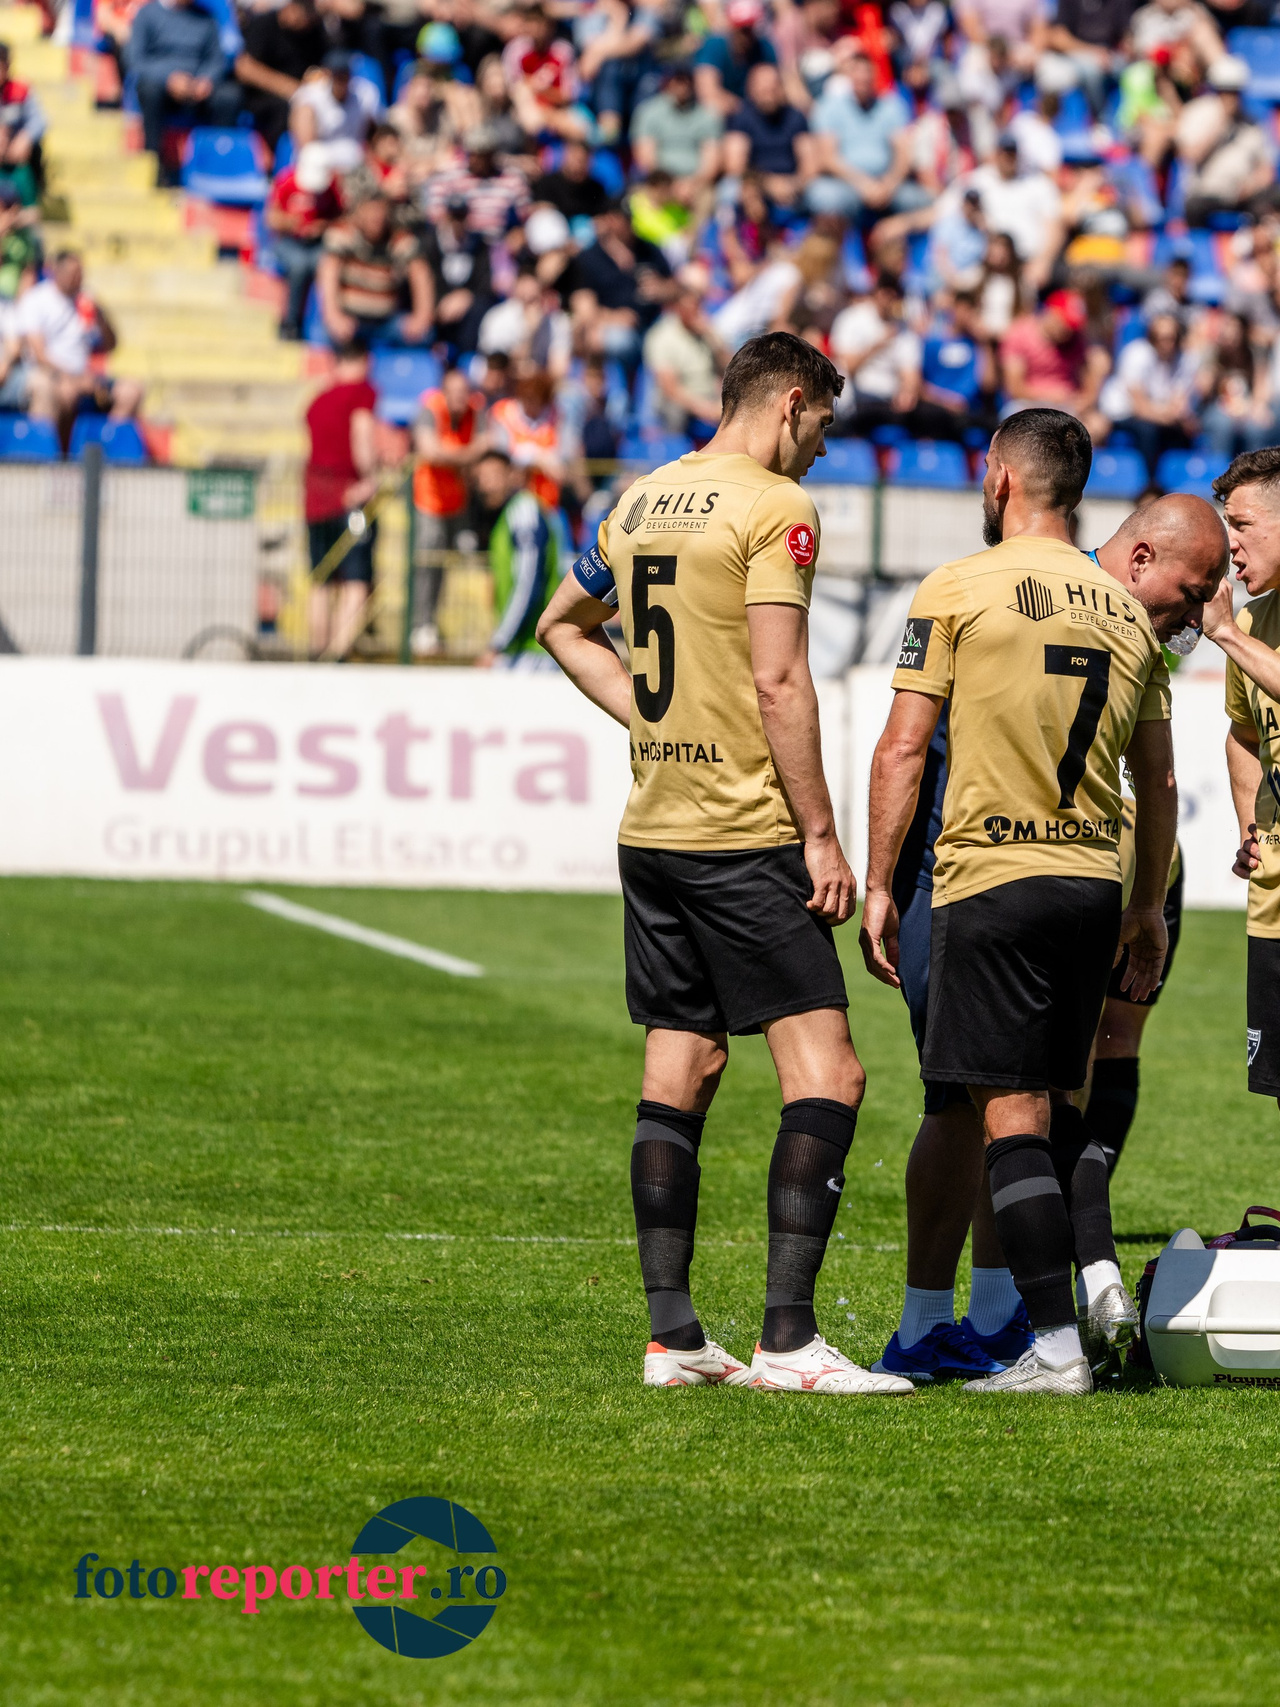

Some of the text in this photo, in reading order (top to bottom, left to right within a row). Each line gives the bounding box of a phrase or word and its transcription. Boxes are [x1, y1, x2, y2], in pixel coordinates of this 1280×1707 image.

[651, 492, 720, 514] HILS
[646, 521, 708, 530] DEVELOPMENT
[648, 566, 659, 575] FCV
[1065, 583, 1136, 623] HILS
[632, 555, 677, 723] 5
[1071, 656, 1089, 666] FCV
[1044, 644, 1112, 810] 7
[97, 691, 591, 806] Vestra
[638, 741, 723, 763] HOSPITAL
[1013, 820, 1037, 840] M
[103, 814, 530, 878] Grupul Elsaco
